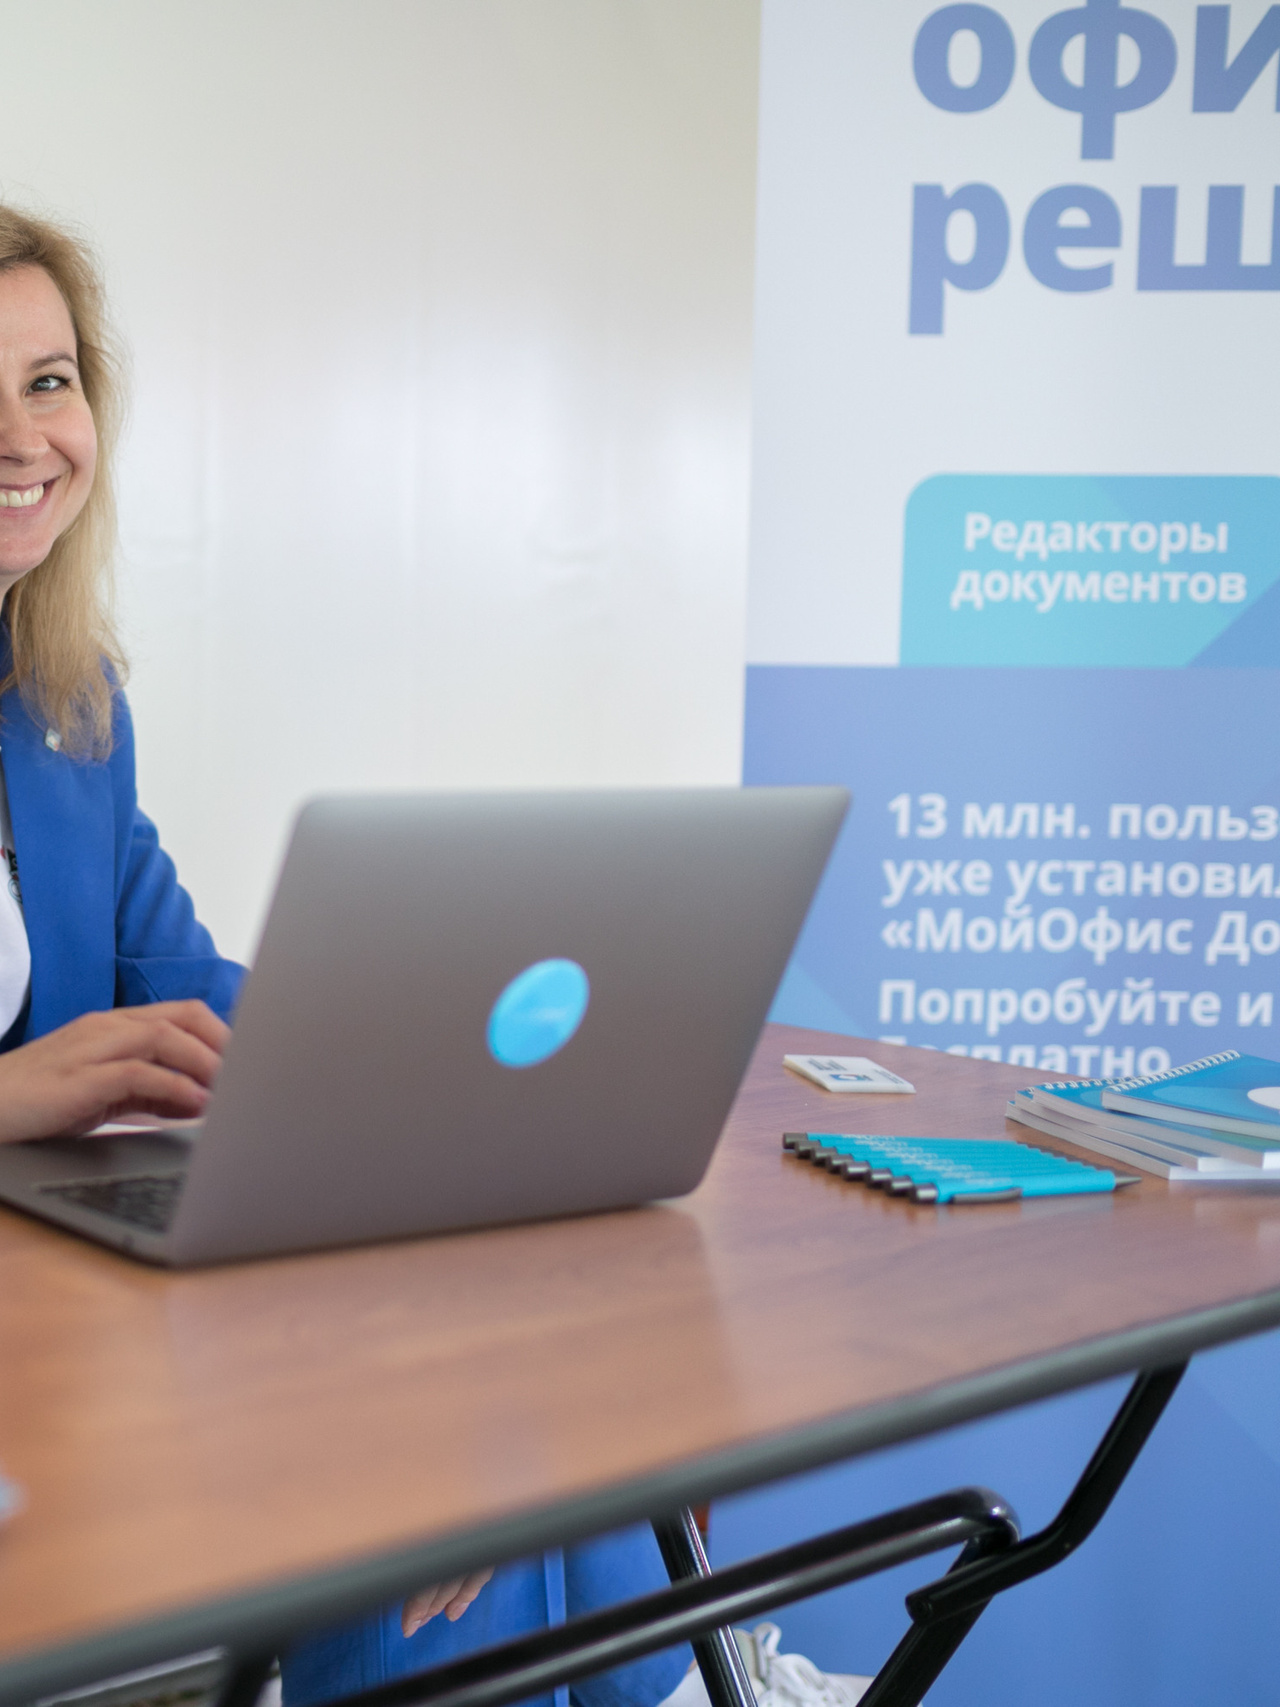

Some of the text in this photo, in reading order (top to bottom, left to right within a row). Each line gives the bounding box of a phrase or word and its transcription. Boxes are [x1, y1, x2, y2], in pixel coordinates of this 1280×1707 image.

[907, 181, 1280, 336] реш
[963, 511, 1229, 564] Редакторы
[949, 568, 1248, 614] документов
[887, 792, 948, 839] 13
[962, 802, 1091, 840] млн.
[881, 859, 1280, 908] уже установи
[880, 904, 1280, 967] «МойОфис До
[878, 977, 1274, 1038] Попробуйте и
